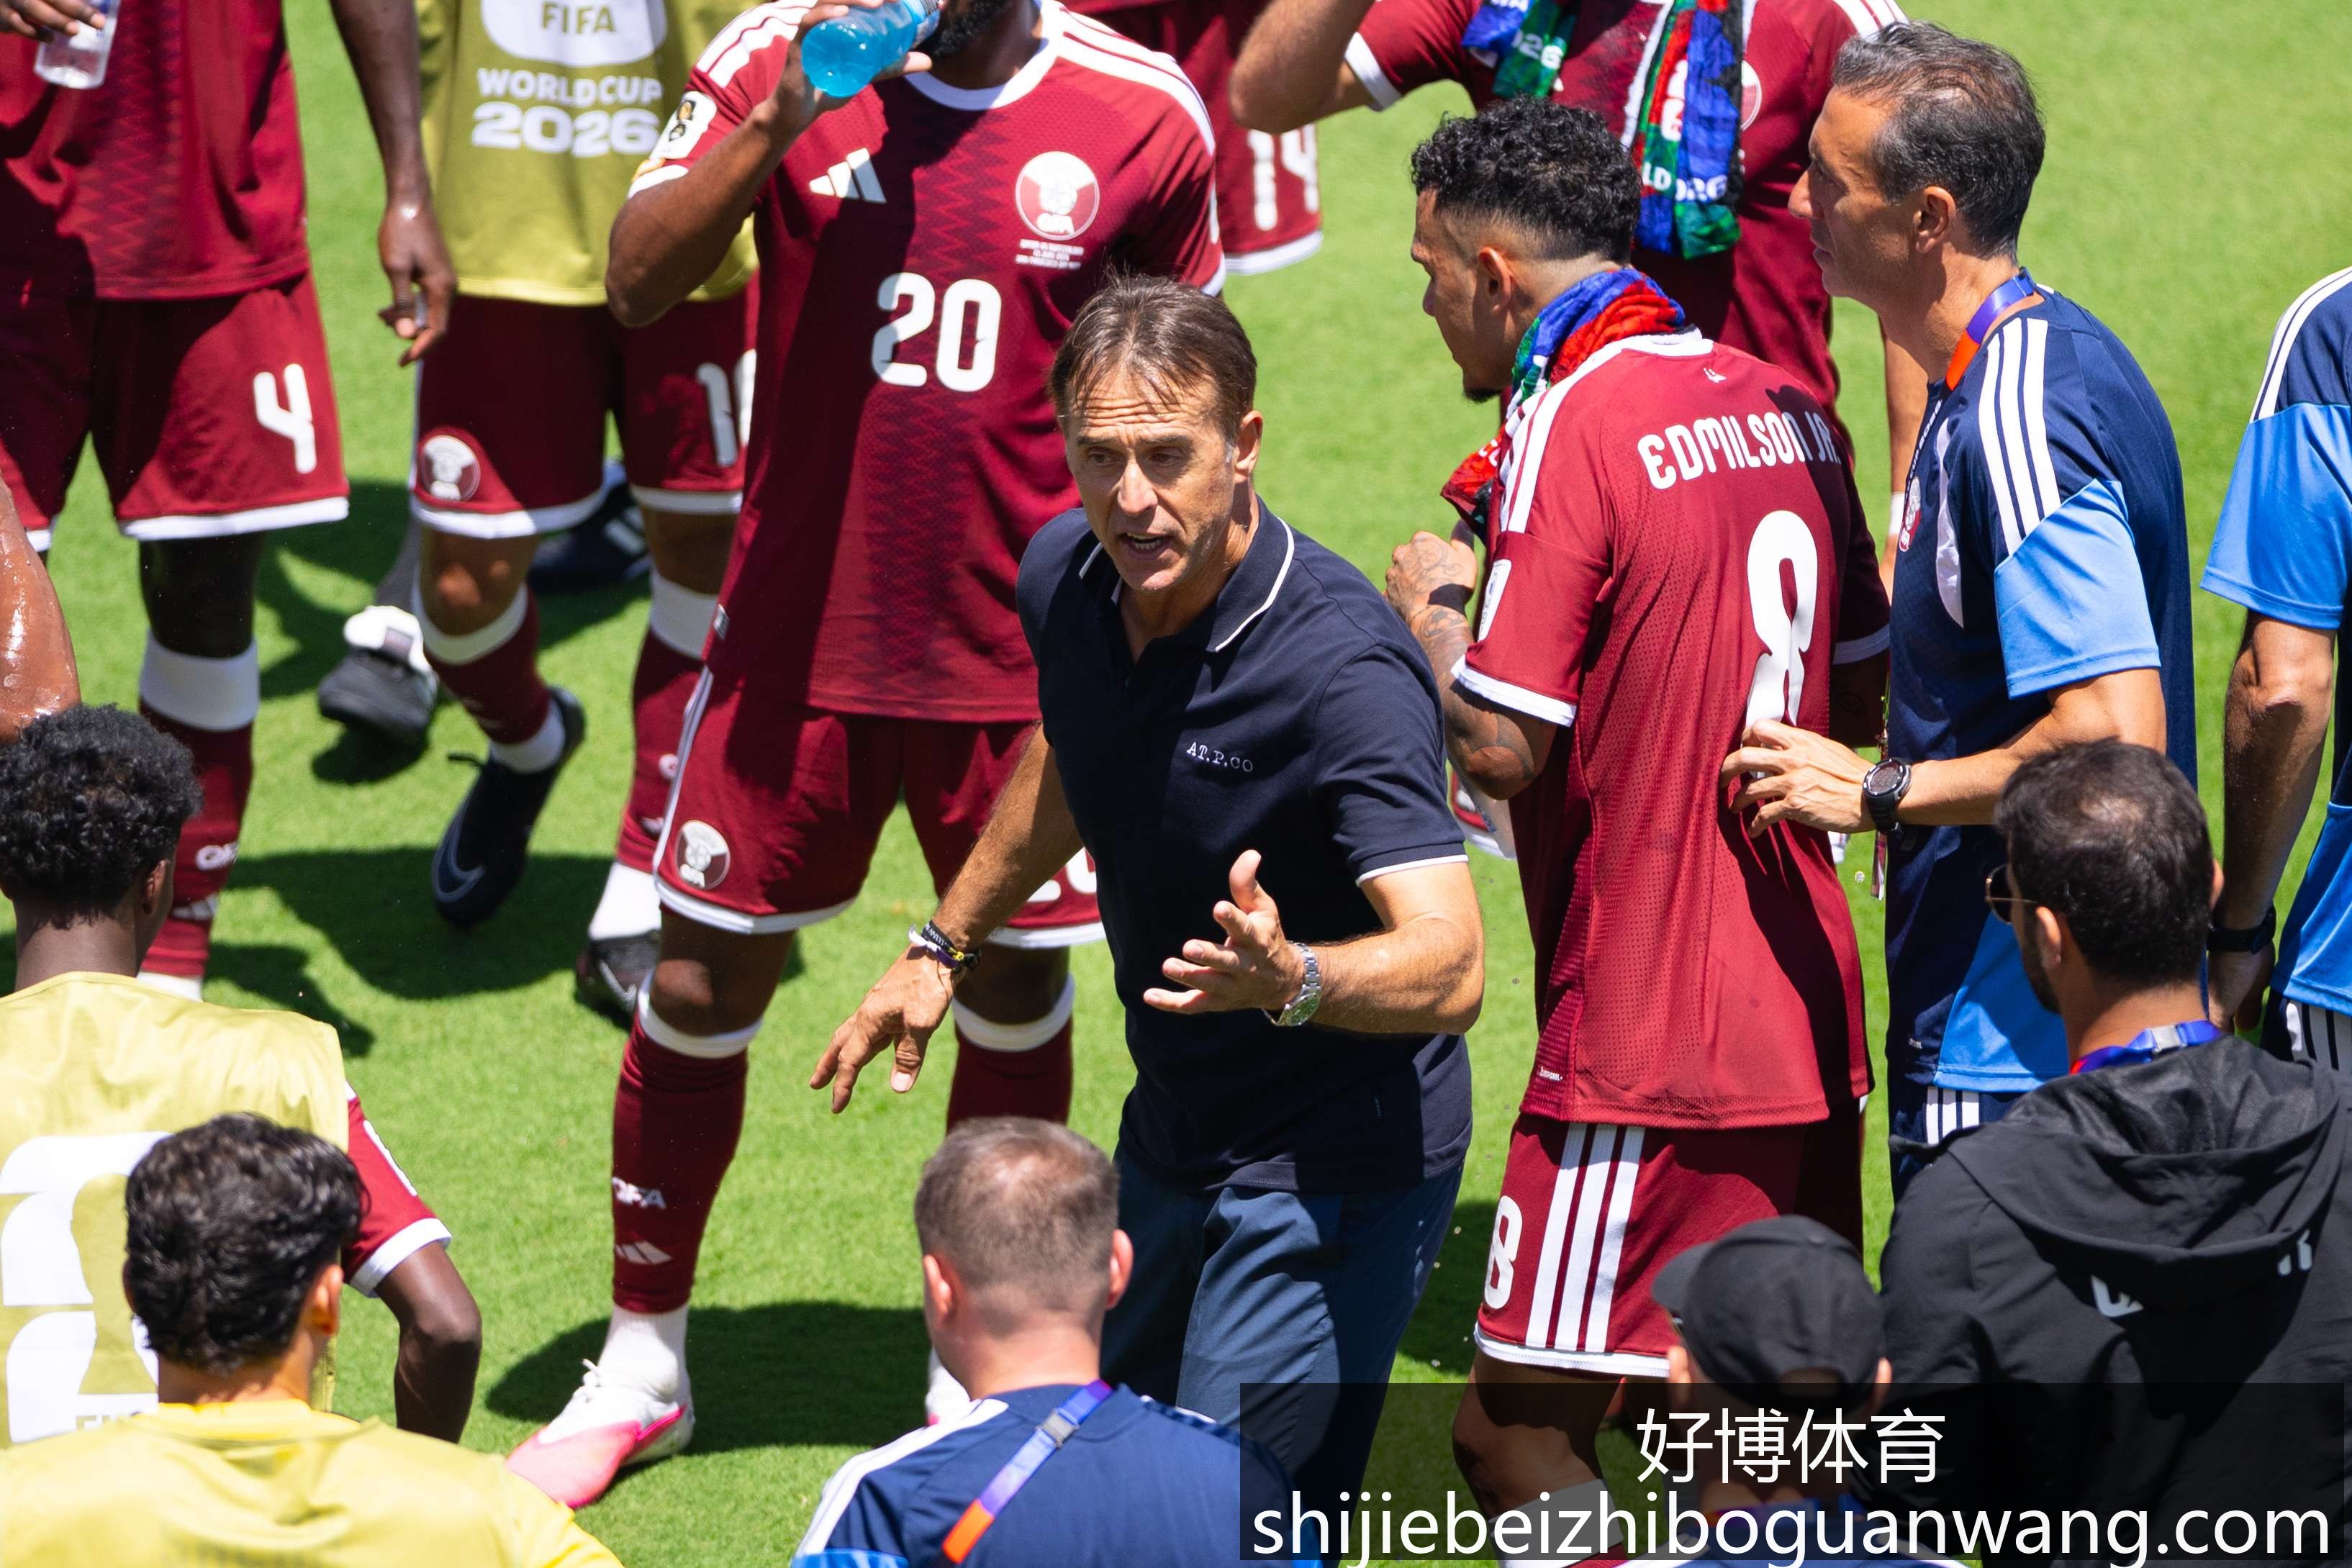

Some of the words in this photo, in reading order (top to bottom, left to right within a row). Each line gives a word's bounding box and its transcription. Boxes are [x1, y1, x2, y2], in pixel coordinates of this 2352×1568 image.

[541, 3, 616, 34] FIFA
[471, 101, 661, 158] 2026
[1247, 123, 1320, 231] 14
[872, 272, 1002, 392] 20
[253, 363, 317, 474] 4
[1637, 411, 1813, 489] EDMILSON
[1745, 509, 1819, 745] 8
[1186, 741, 1253, 772] AT.P.CO
[1484, 1195, 1523, 1309] 8
